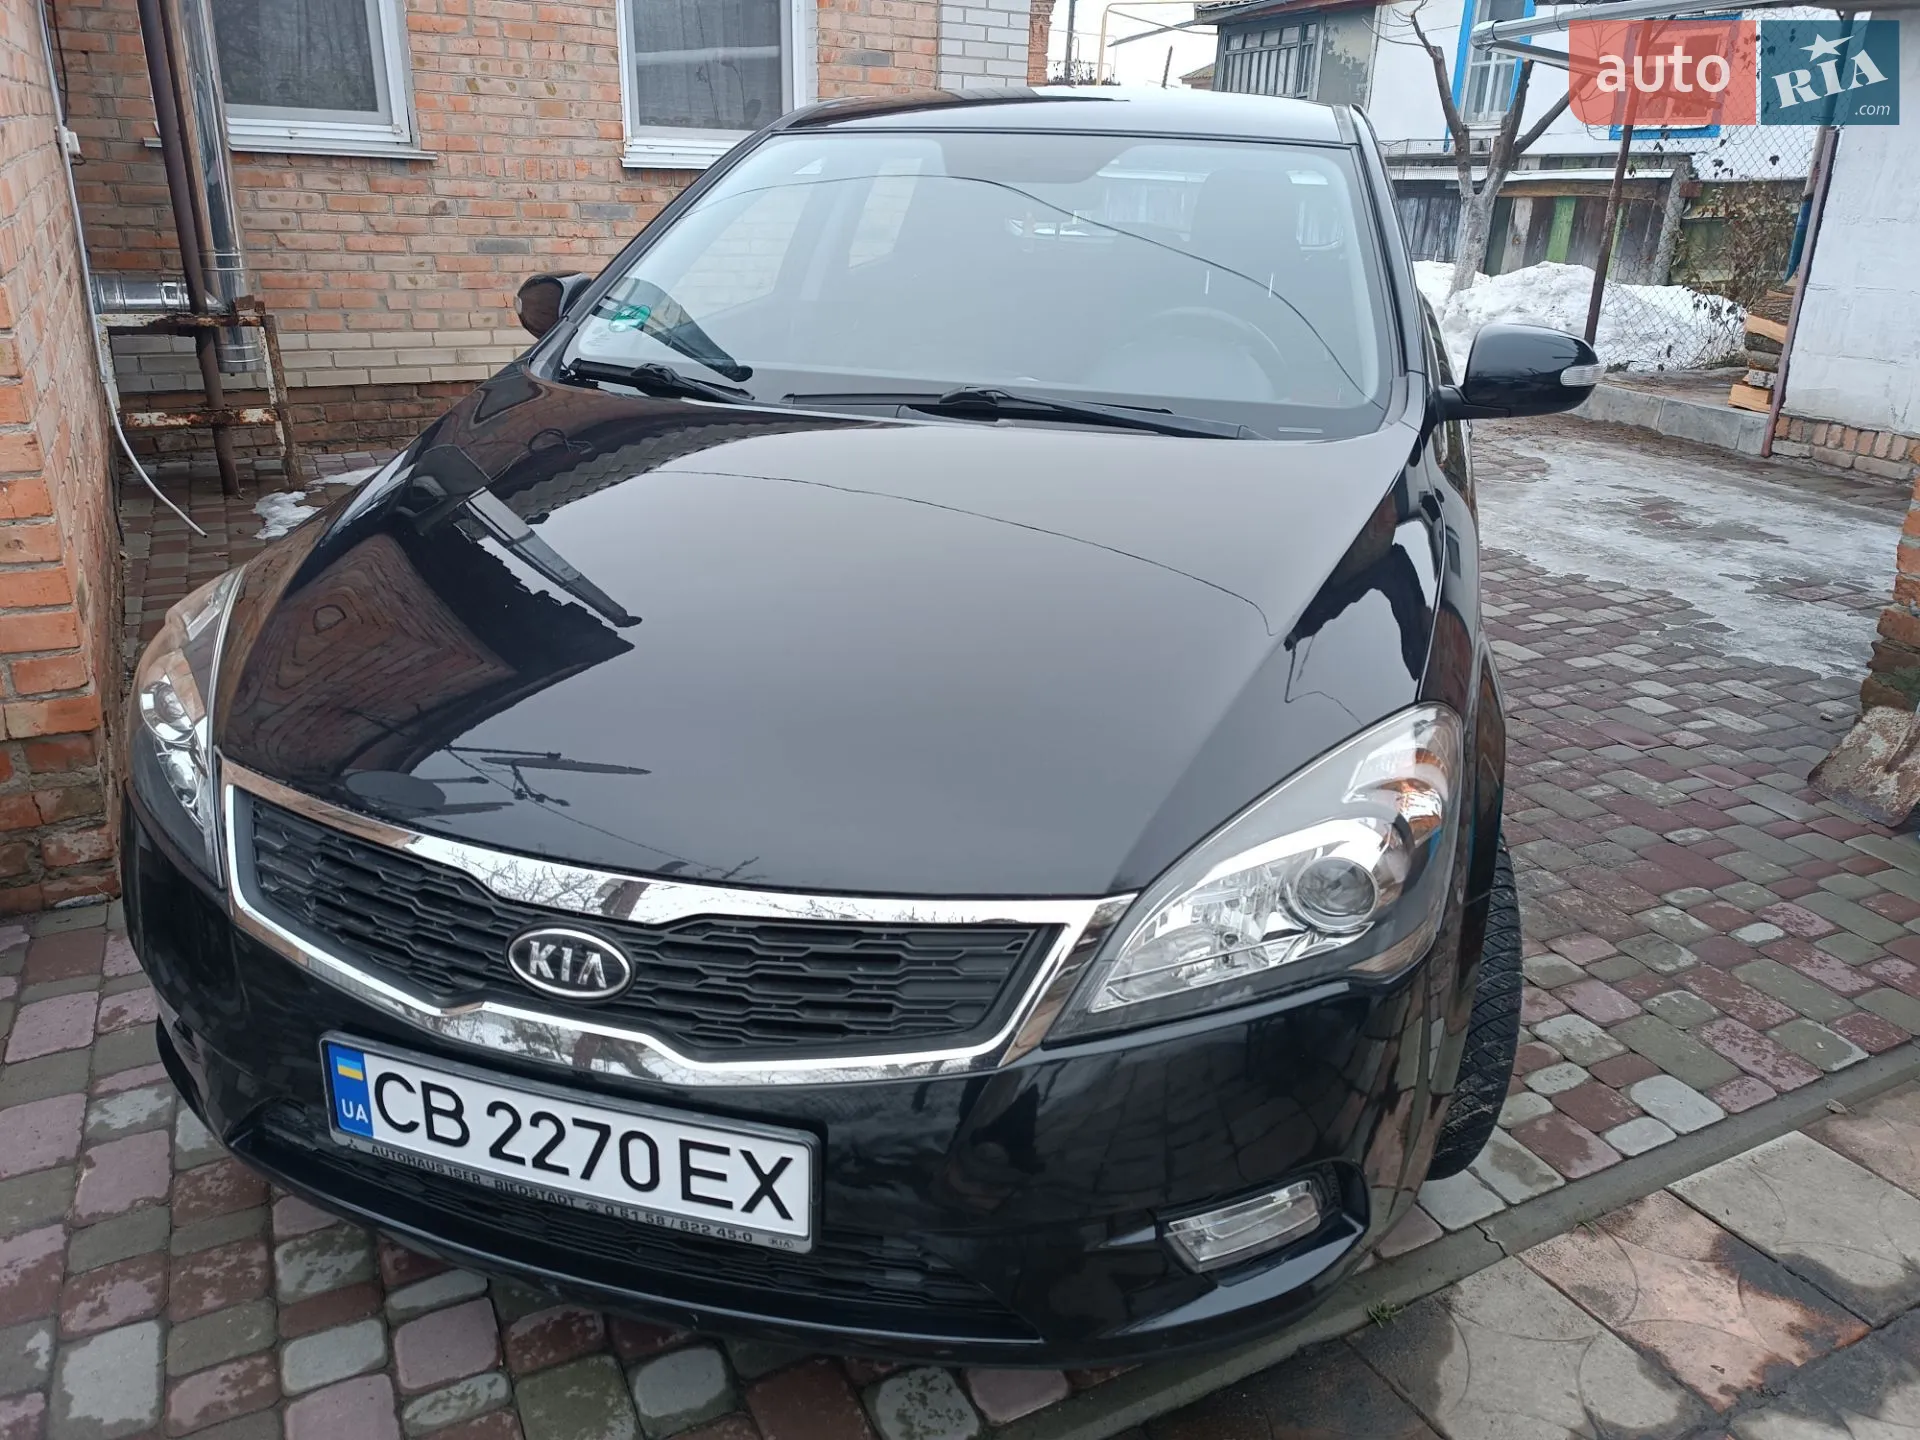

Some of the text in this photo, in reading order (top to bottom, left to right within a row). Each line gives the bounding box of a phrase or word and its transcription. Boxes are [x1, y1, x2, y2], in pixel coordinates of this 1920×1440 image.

[528, 939, 607, 989] KIA
[341, 1098, 369, 1124] UA
[374, 1071, 794, 1222] CB 2270 EX
[371, 1144, 445, 1174] AUTOHAUS
[494, 1180, 576, 1208] RIEDSTADT
